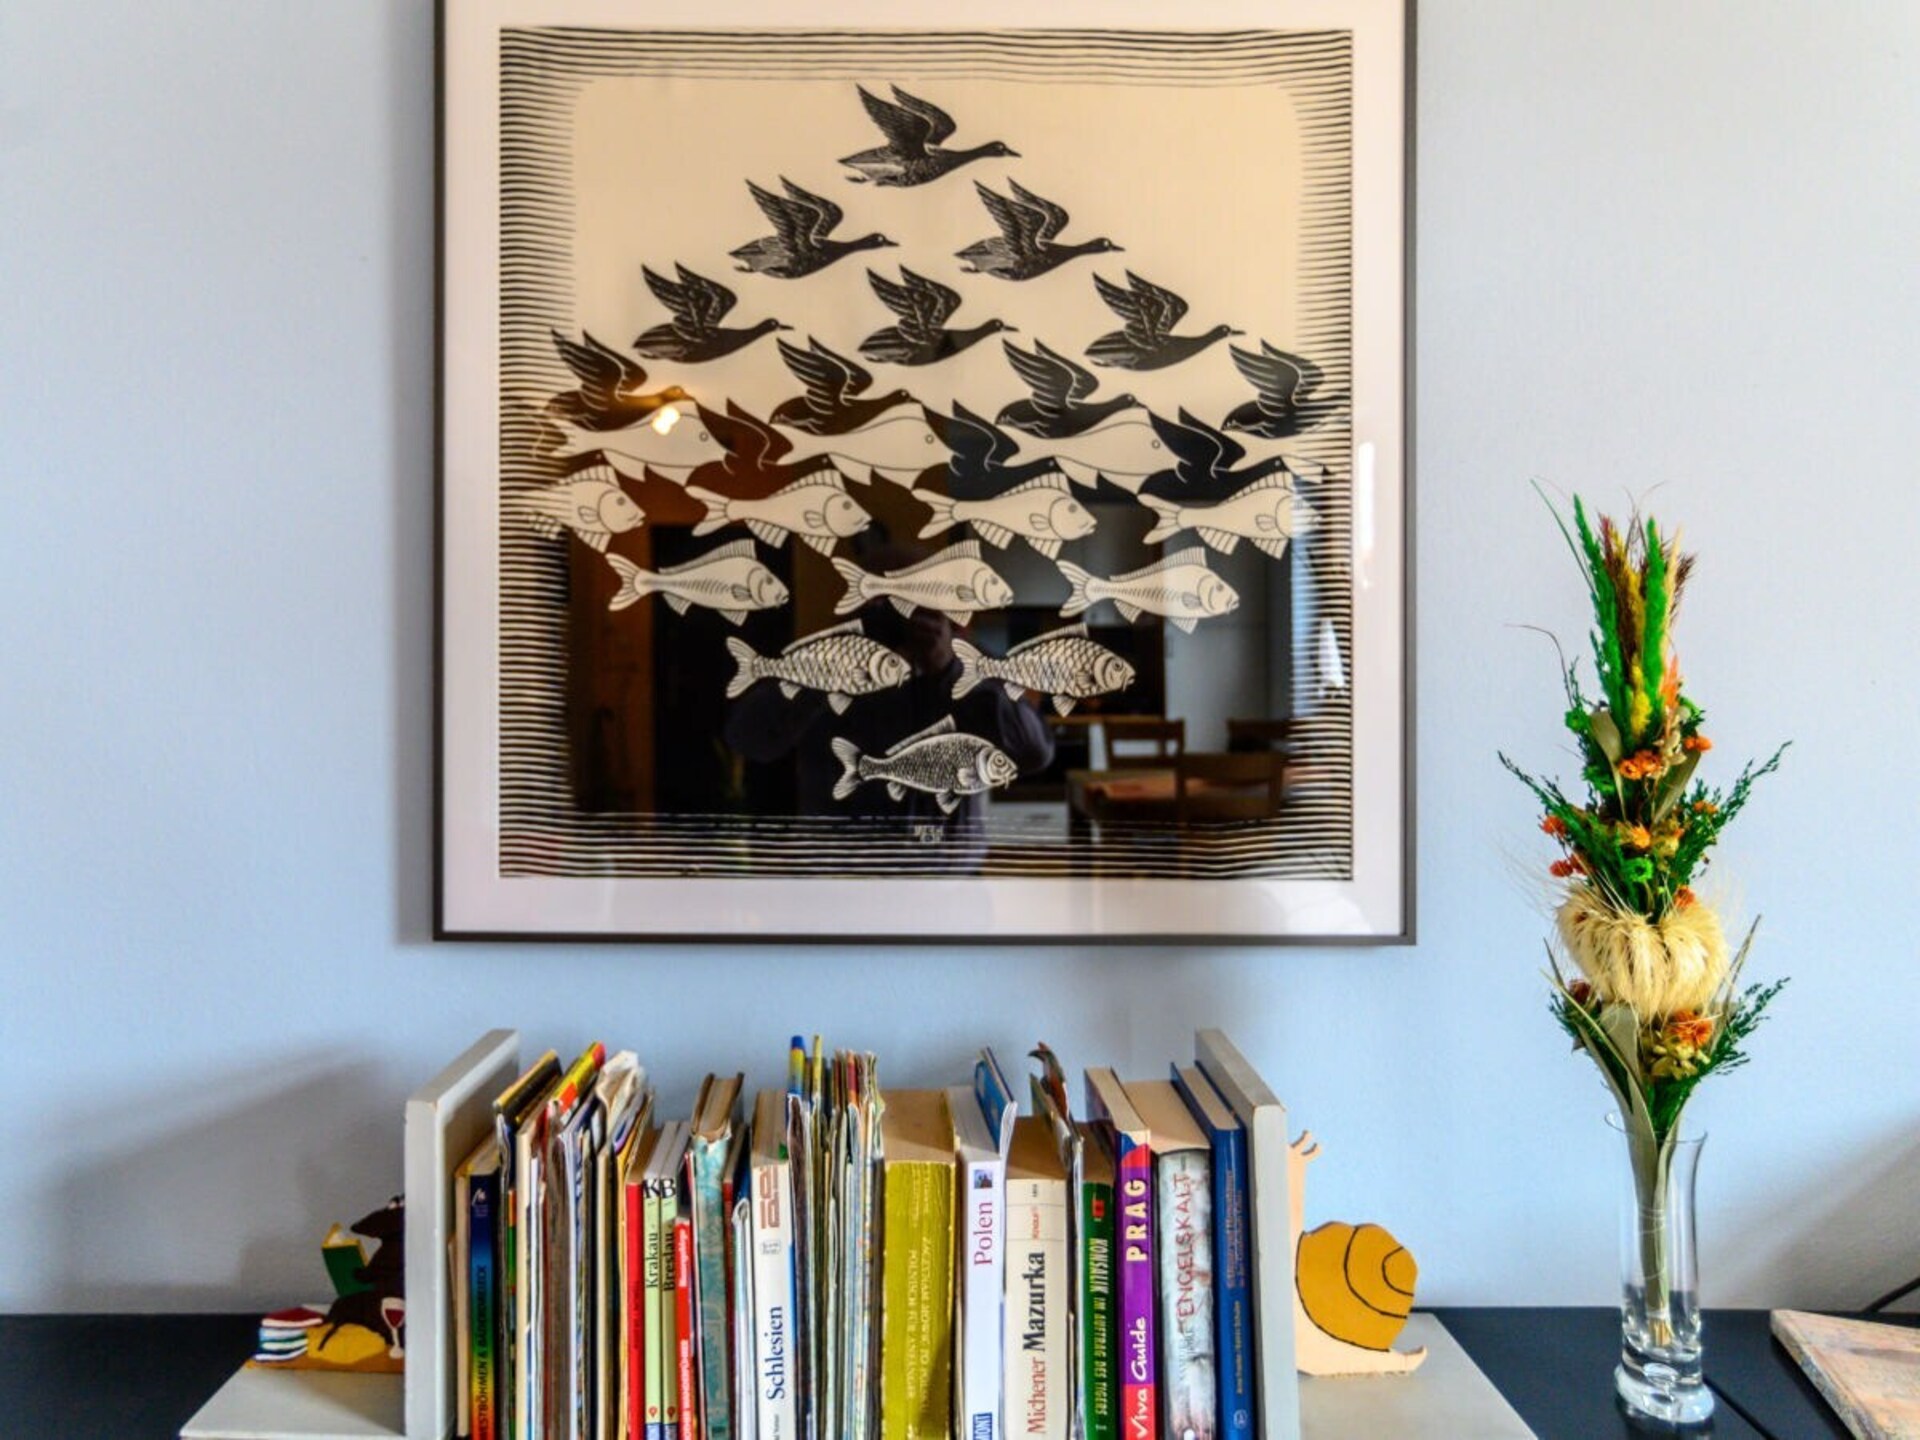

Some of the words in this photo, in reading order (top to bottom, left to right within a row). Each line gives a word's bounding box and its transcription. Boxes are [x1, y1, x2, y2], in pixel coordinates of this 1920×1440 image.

[642, 1178, 660, 1198] K
[659, 1178, 676, 1198] B
[973, 1202, 993, 1266] Polen
[1124, 1179, 1147, 1262] PRAG
[1173, 1173, 1196, 1318] ENGELSKALT
[645, 1232, 658, 1289] Krakau
[663, 1232, 675, 1292] Breslau
[1090, 1238, 1108, 1293] KONSALIK
[1022, 1251, 1045, 1352] Mazurka
[765, 1305, 786, 1401] Schlesien
[1094, 1313, 1107, 1355] AUFTRAG
[1131, 1316, 1147, 1381] Guide
[1027, 1356, 1046, 1434] Michener
[1094, 1359, 1107, 1379] DES
[1095, 1381, 1107, 1416] TIGERS
[1130, 1388, 1148, 1439] Viva
